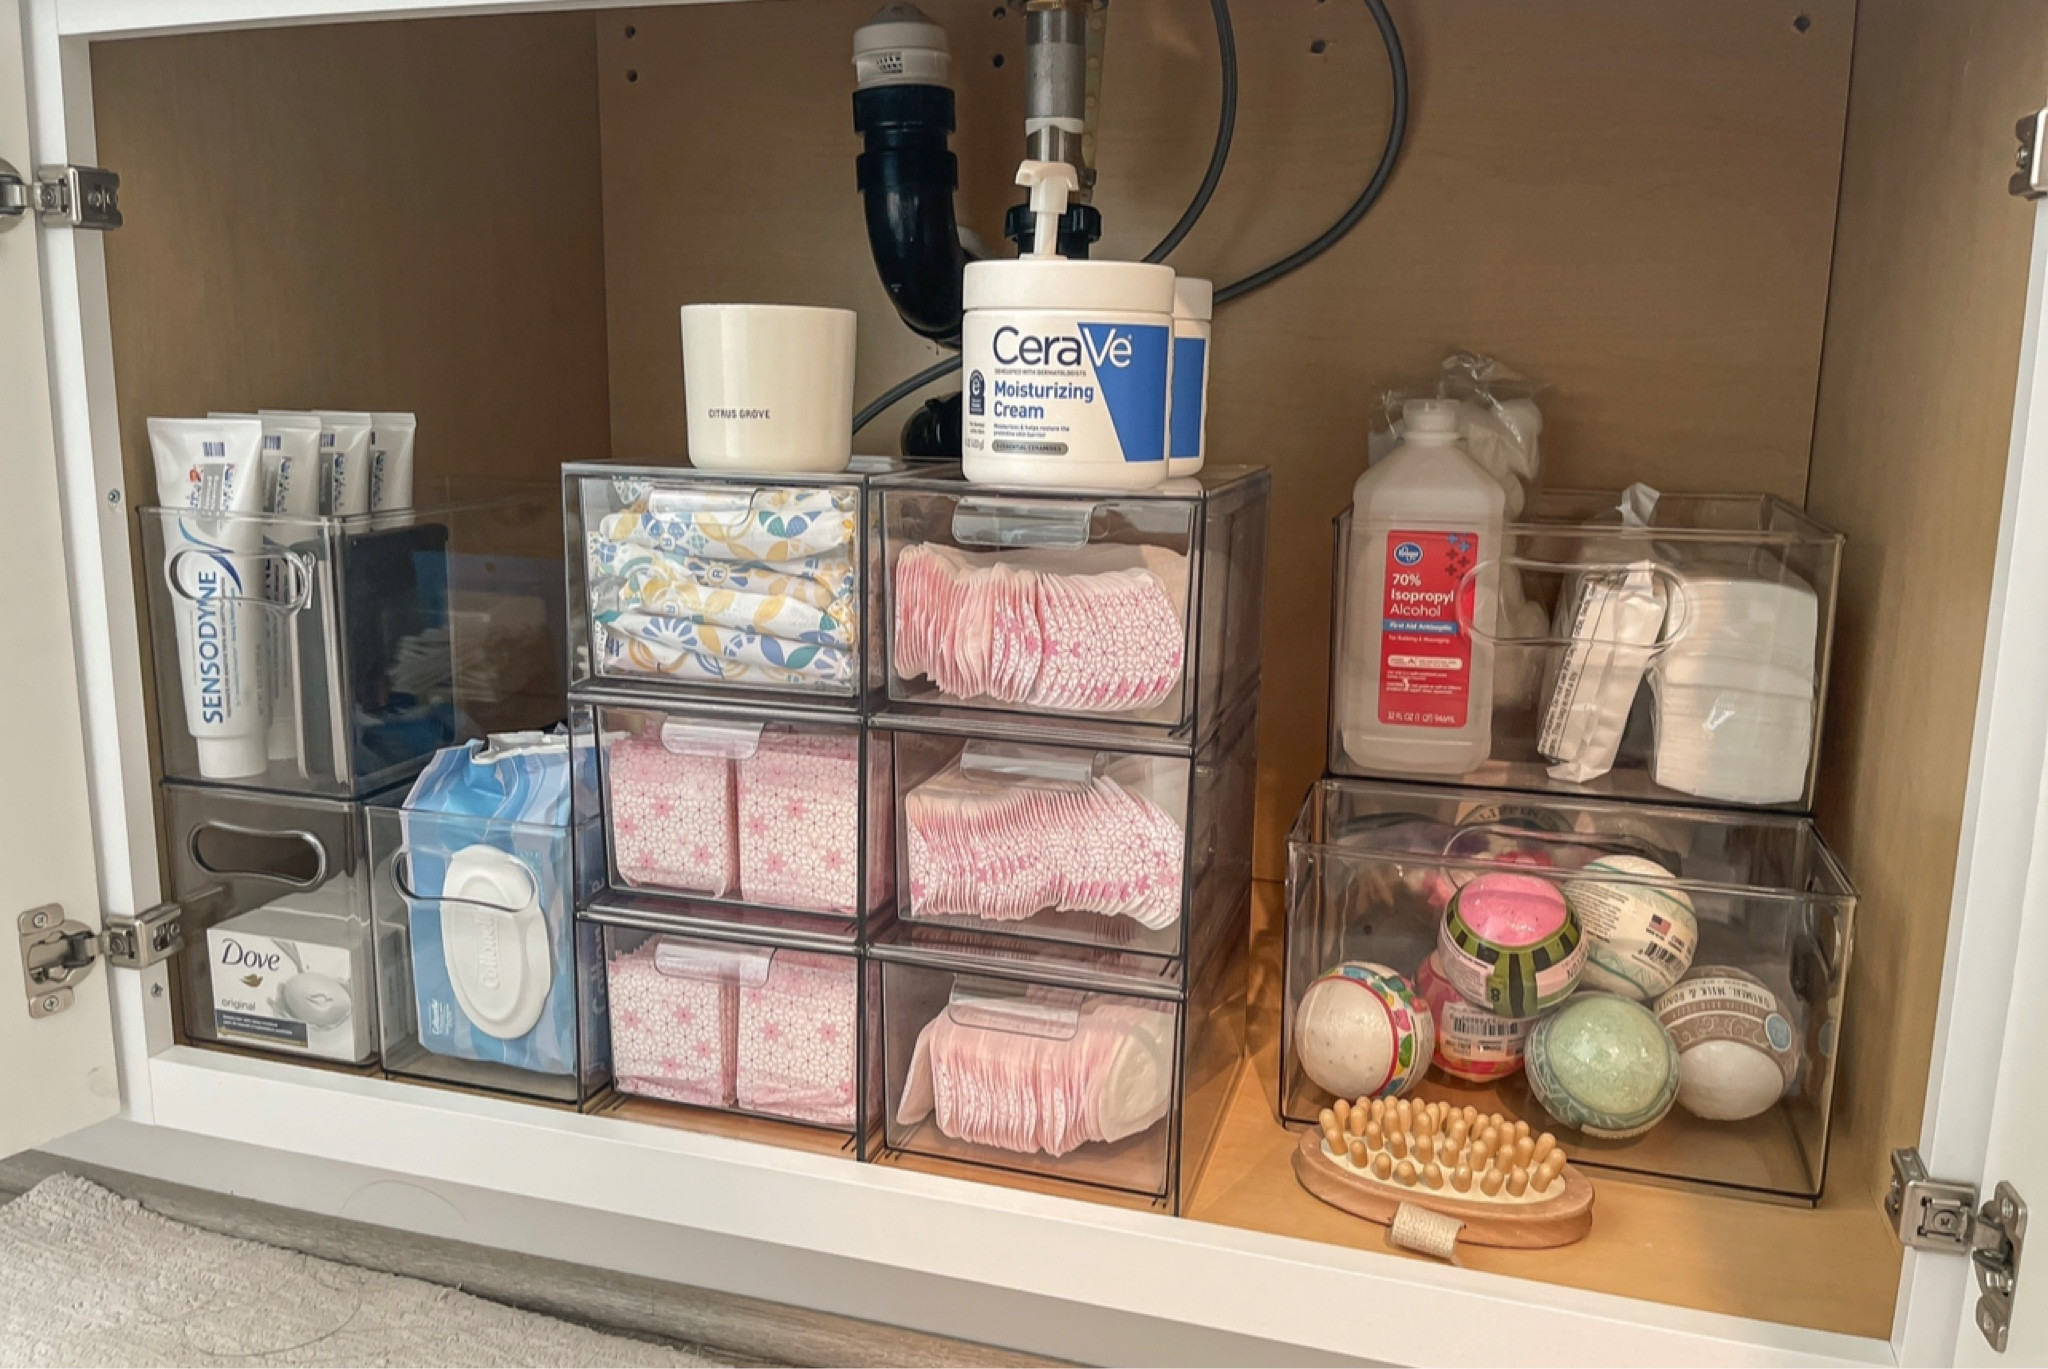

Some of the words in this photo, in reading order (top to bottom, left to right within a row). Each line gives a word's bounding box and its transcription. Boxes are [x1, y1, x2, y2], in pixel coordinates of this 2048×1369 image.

[993, 325, 1132, 368] CeraVe
[994, 380, 1094, 404] Moisturizing
[708, 408, 737, 419] CITRUS
[739, 408, 770, 419] GROVE
[993, 400, 1044, 418] Cream
[1392, 573, 1421, 587] 70%
[1391, 588, 1454, 606] Isopropyl
[1390, 603, 1441, 617] Alcohol
[198, 571, 223, 724] SENSODYNE
[222, 937, 280, 971] Dove
[222, 997, 255, 1011] original
